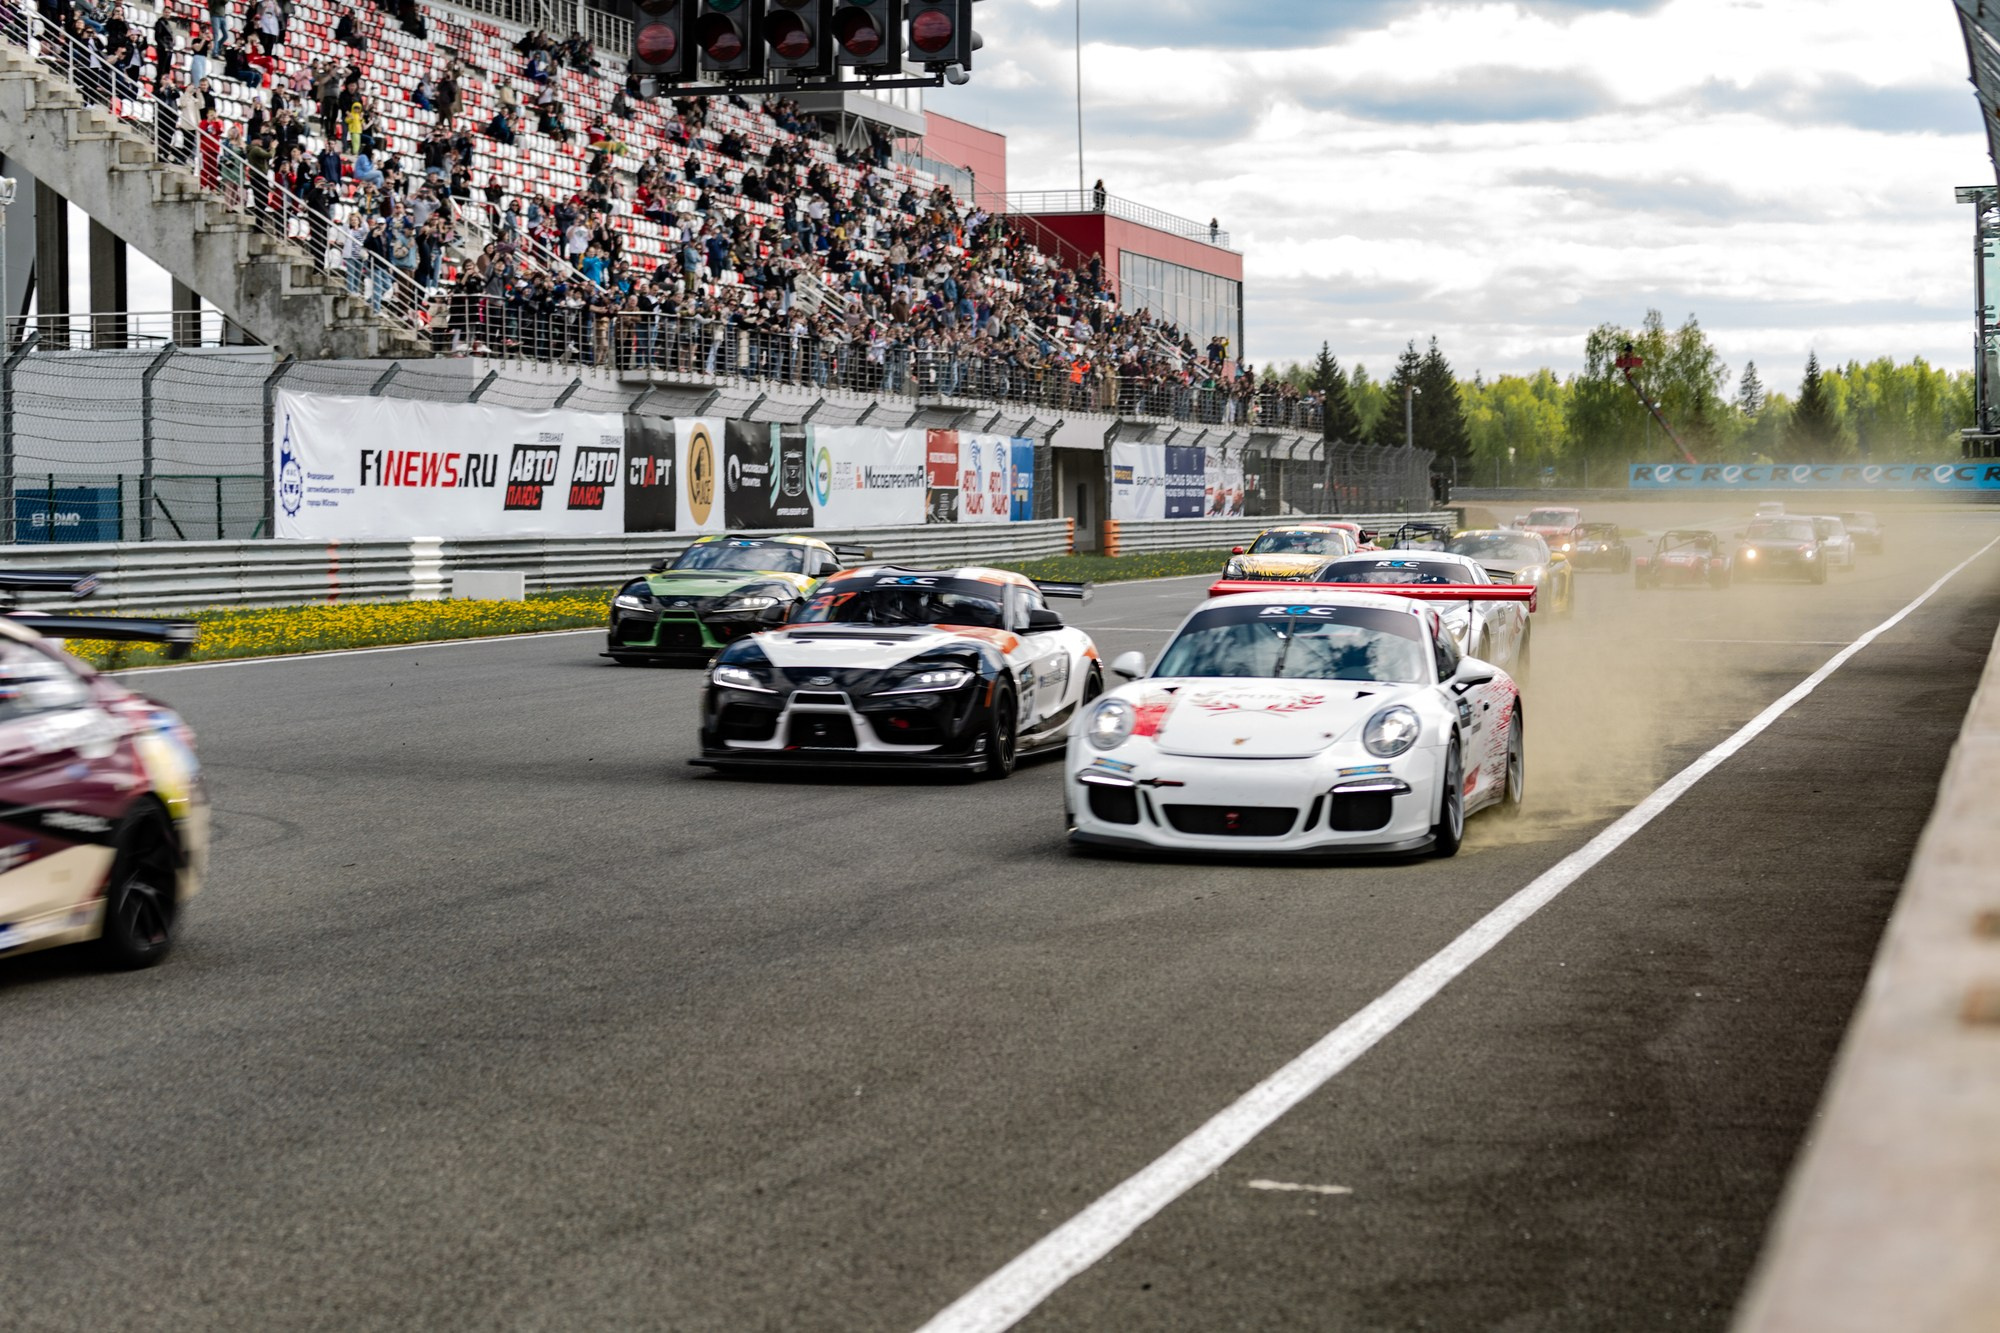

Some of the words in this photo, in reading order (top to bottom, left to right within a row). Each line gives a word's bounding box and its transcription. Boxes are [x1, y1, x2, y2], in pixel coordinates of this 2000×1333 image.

[360, 449, 498, 488] F1NEWS.RU
[510, 449, 558, 482] АВТО
[573, 451, 619, 483] АВТО
[629, 455, 672, 488] СТАРТ
[506, 485, 541, 506] ПЛЮС
[570, 485, 603, 506] ПЛЮС
